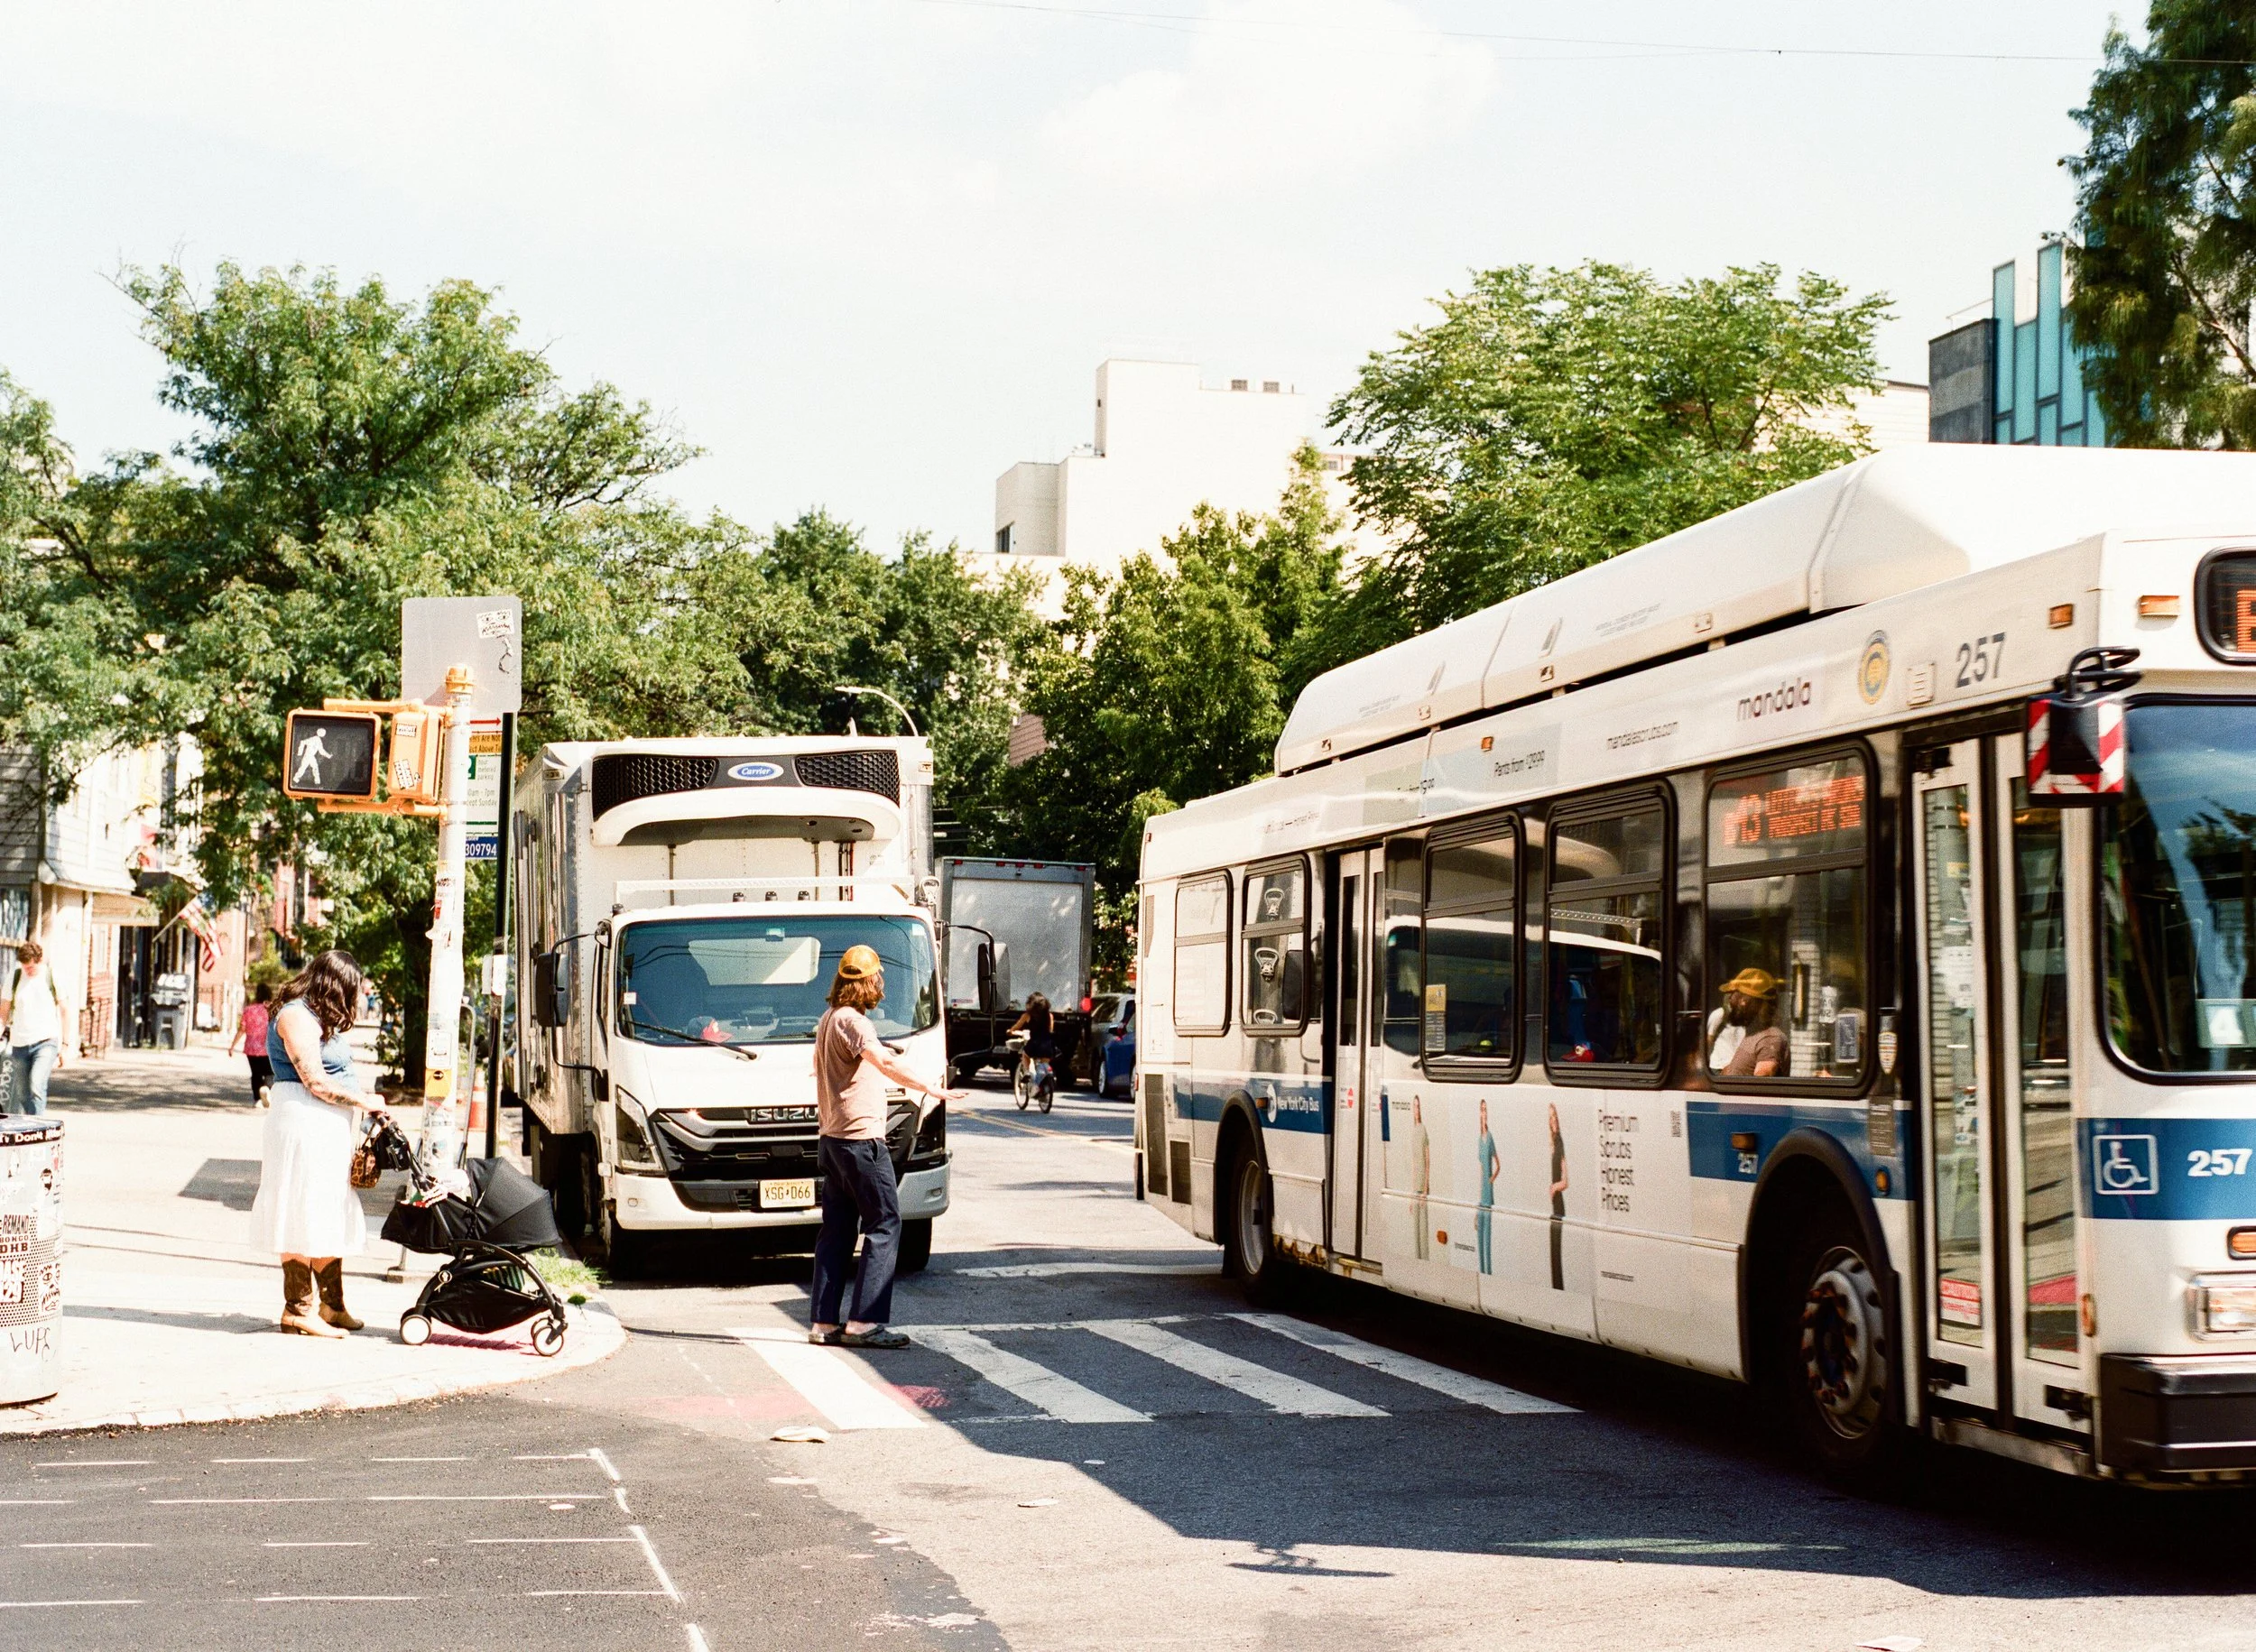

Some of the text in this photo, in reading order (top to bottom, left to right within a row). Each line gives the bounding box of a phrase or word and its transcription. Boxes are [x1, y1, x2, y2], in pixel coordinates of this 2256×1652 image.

[1956, 632, 2004, 688] 257
[1737, 677, 1811, 722] mandala
[741, 767, 771, 775] Carrier
[466, 844, 497, 856] 309794
[751, 1107, 818, 1121] ISUZU
[1598, 1109, 1639, 1133] Premium
[1599, 1134, 1632, 1159] Scrubs
[1600, 1160, 1634, 1186] Honest
[2187, 1148, 2252, 1177] 257
[1602, 1187, 1630, 1213] Prices
